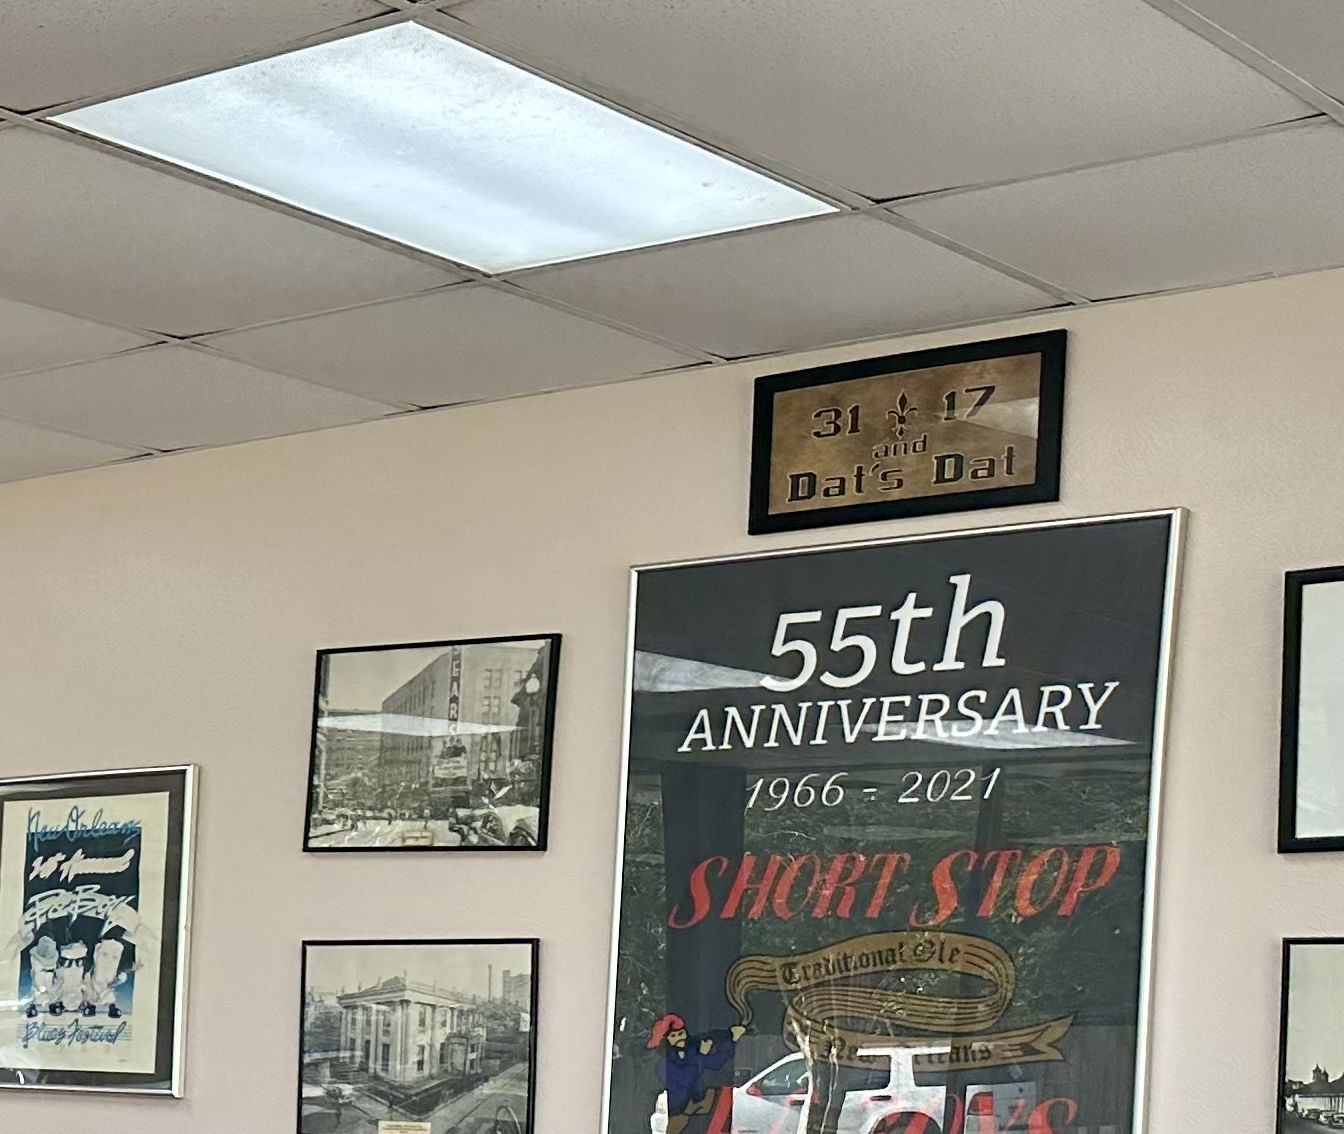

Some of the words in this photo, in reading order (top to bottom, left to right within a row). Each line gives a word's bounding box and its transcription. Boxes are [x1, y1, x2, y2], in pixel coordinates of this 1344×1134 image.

[812, 404, 861, 438] 31
[942, 385, 996, 421] 17
[872, 434, 927, 459] and
[787, 465, 904, 502] Dat's
[932, 446, 1016, 486] Dat
[760, 574, 1008, 692] 55th
[678, 681, 1120, 753] ANNIVERSARY
[745, 771, 846, 813] 1966
[898, 767, 1002, 805] 2021
[28, 807, 64, 852] New
[65, 805, 142, 846] Orleans
[667, 851, 913, 930] SHORT
[910, 845, 1122, 928] STOP
[779, 944, 907, 986] Traditional
[912, 939, 962, 965] Ole
